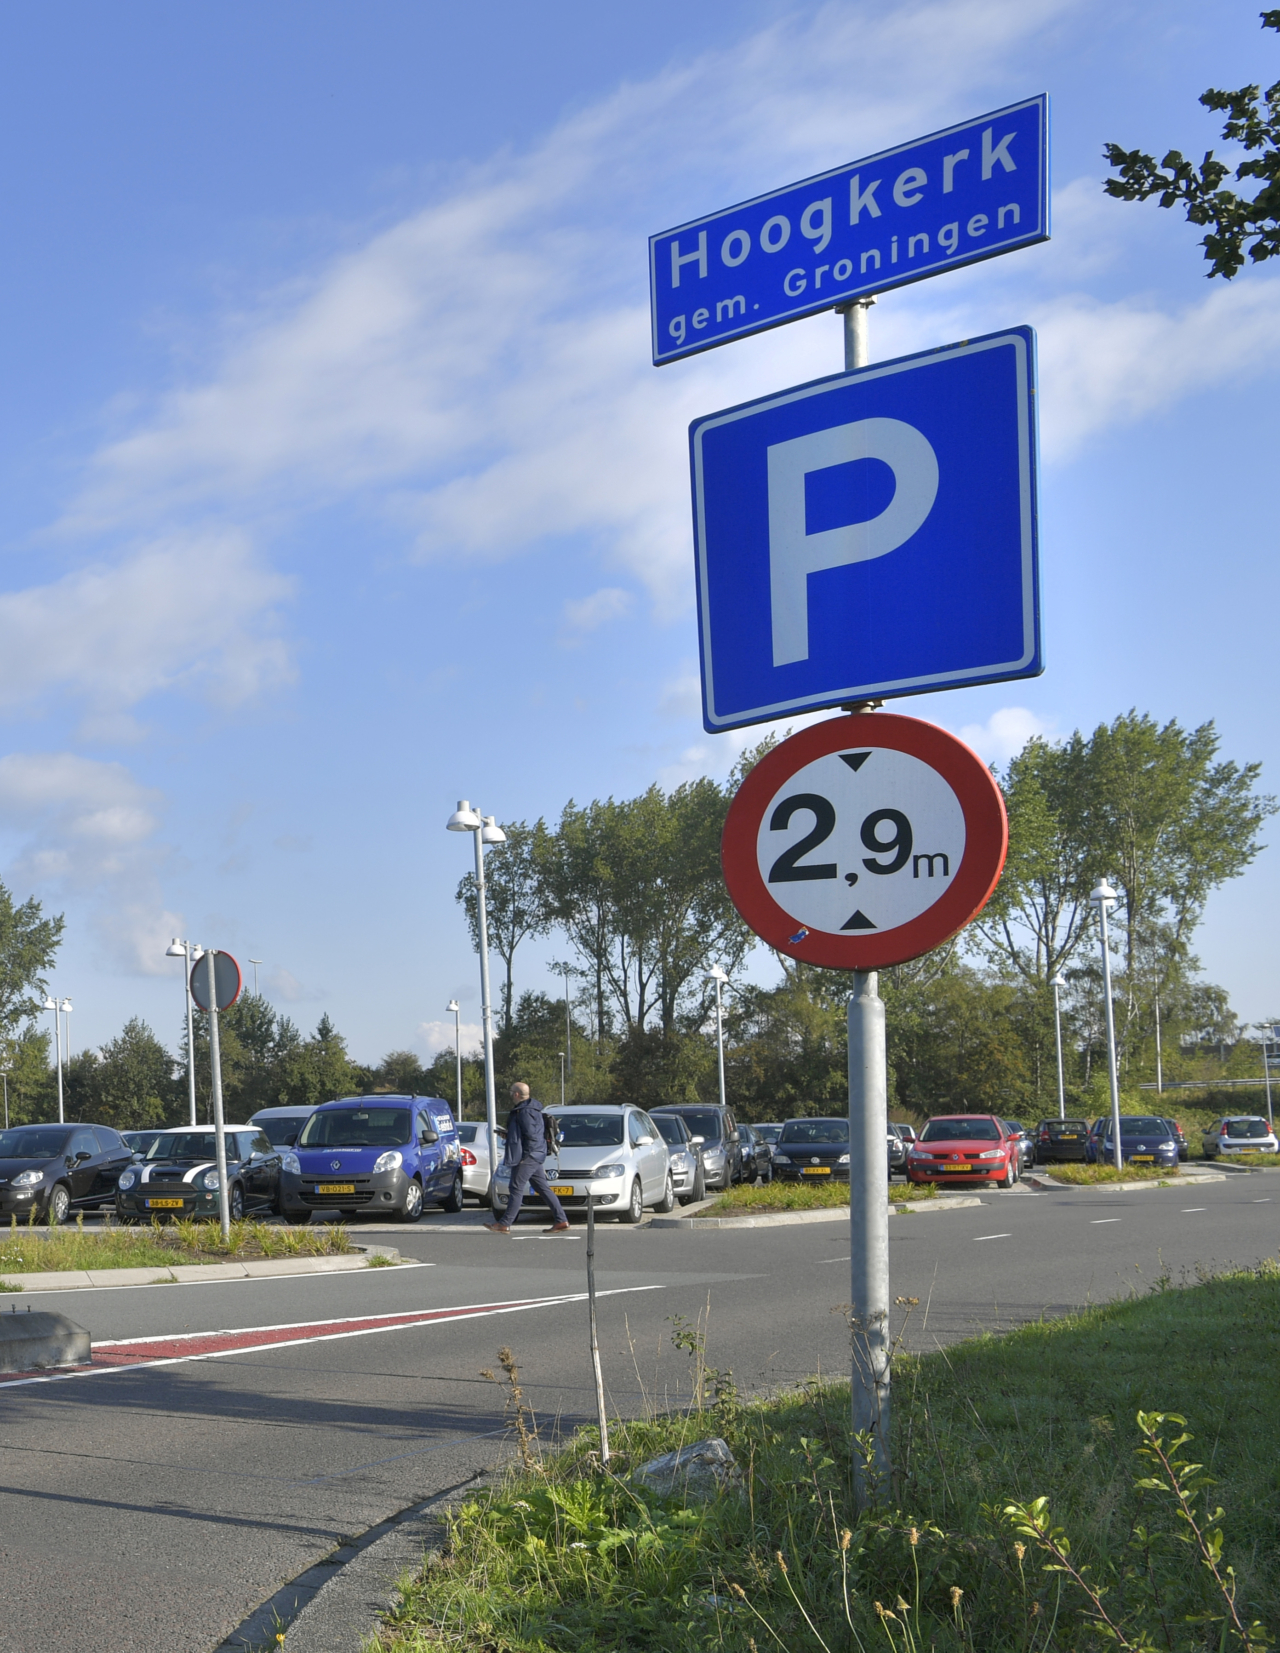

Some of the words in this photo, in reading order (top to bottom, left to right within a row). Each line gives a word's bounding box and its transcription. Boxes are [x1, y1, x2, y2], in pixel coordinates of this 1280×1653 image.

[668, 293, 760, 345] gem.
[783, 202, 1020, 297] Groningen
[670, 126, 1018, 288] Hoogkerk
[766, 417, 940, 667] P
